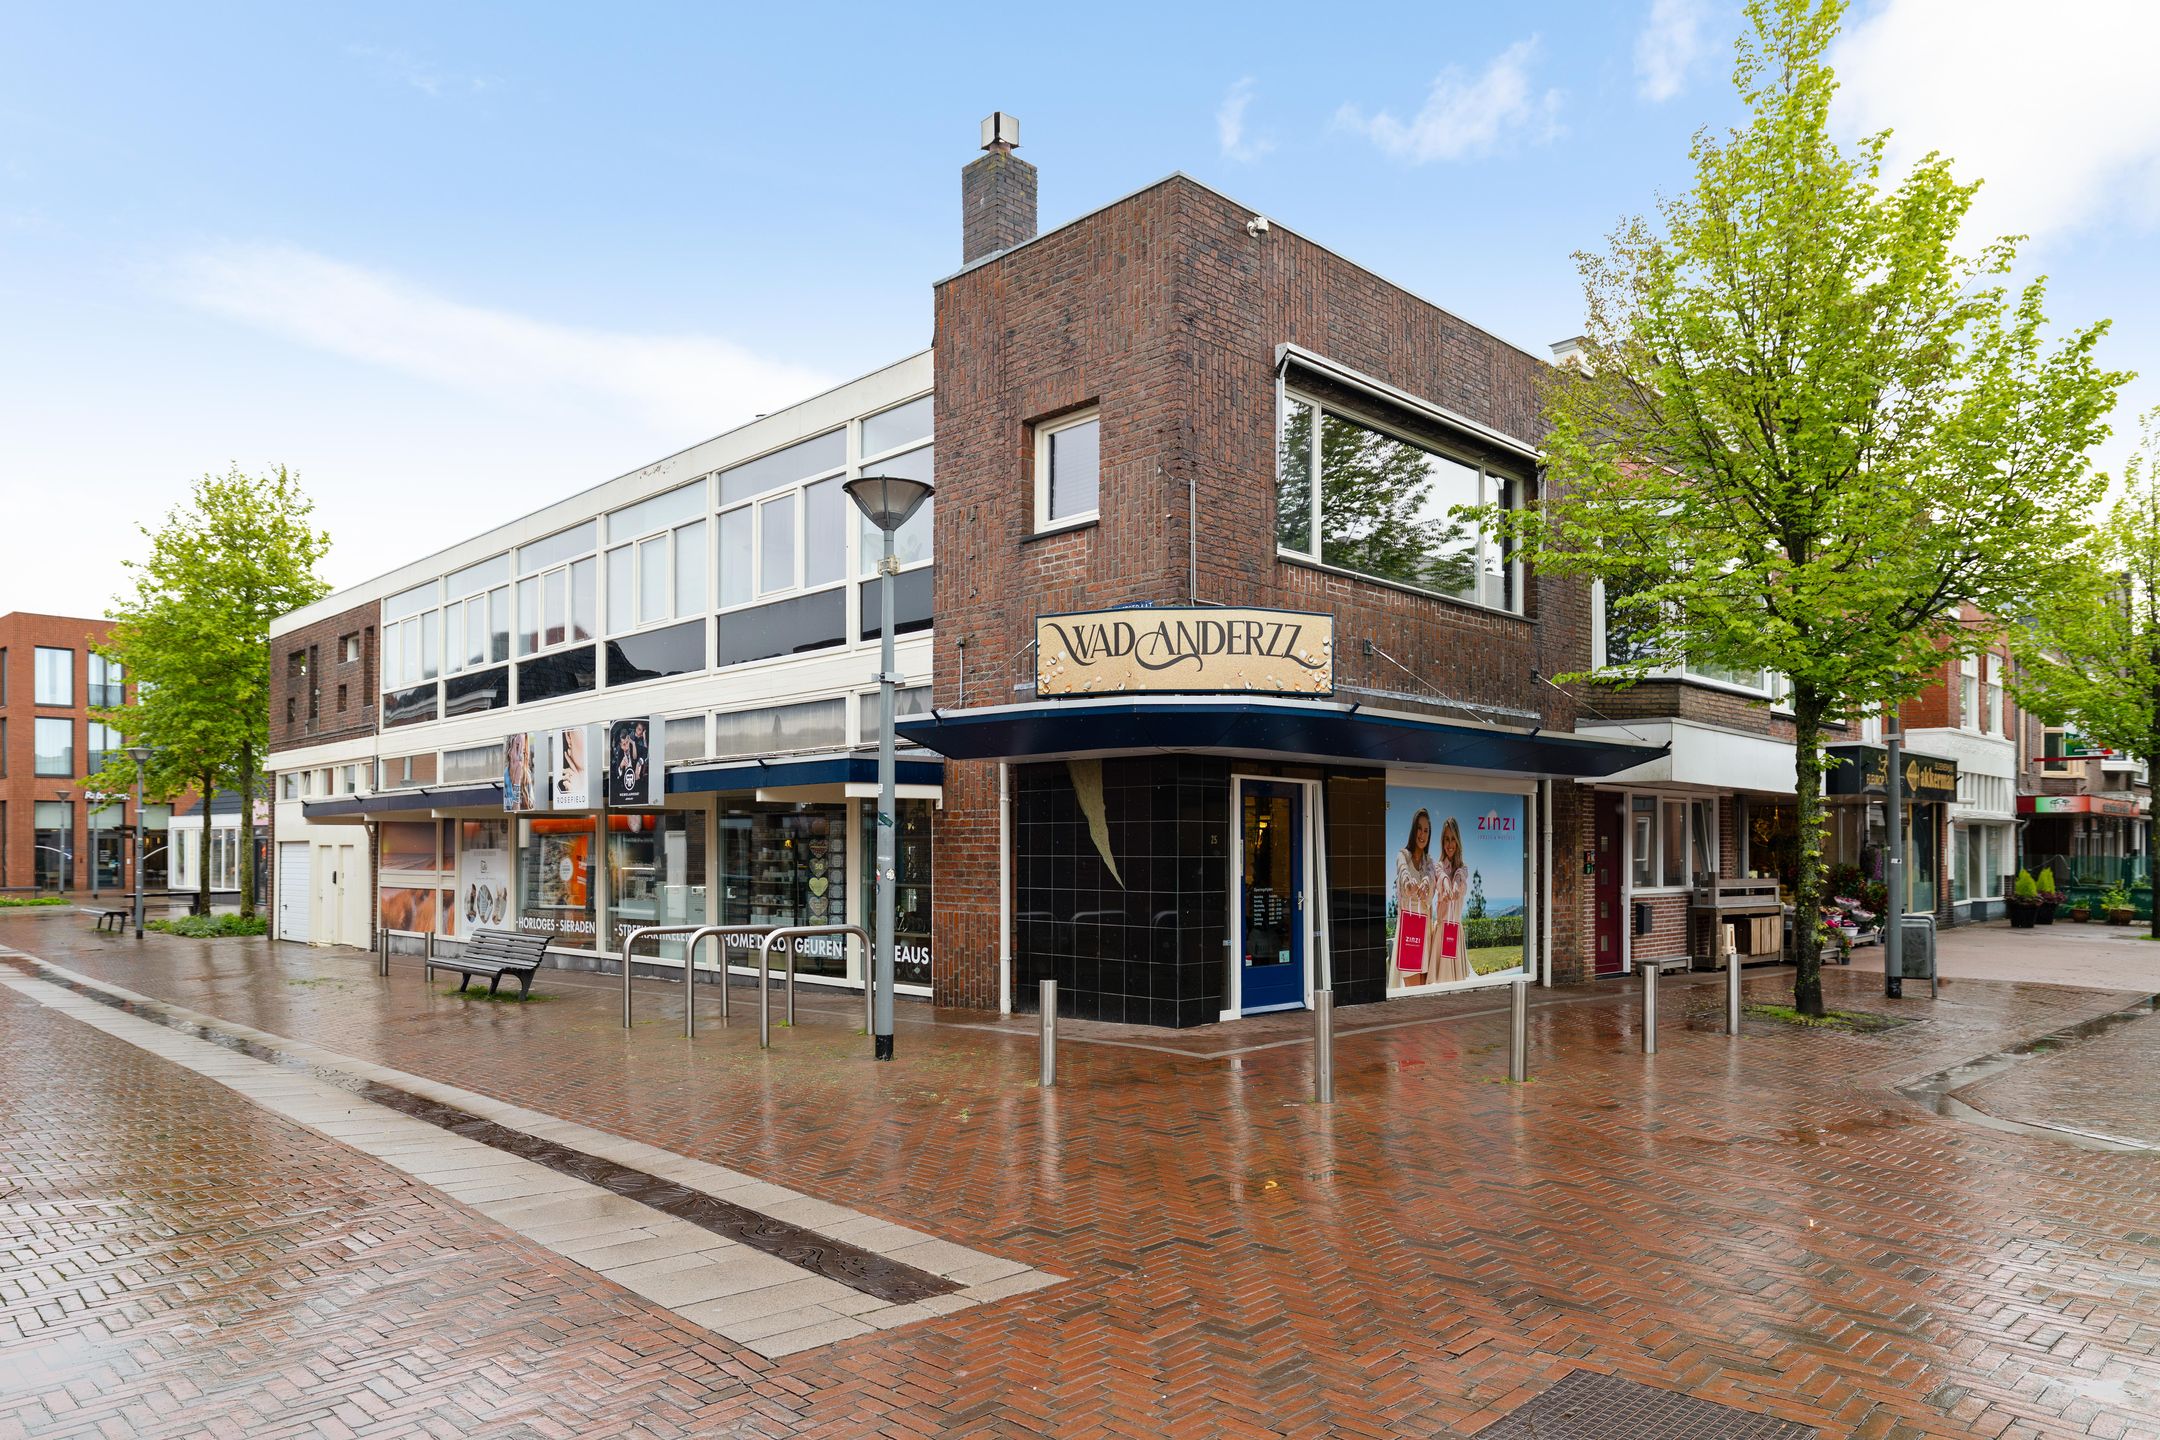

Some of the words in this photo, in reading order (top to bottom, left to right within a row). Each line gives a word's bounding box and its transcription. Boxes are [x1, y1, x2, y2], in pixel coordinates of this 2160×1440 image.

[556, 795, 586, 804] ROSEFIELD
[518, 917, 555, 931] HORLOGES
[559, 919, 596, 934] SIERADEN
[794, 937, 843, 957] GEUREN
